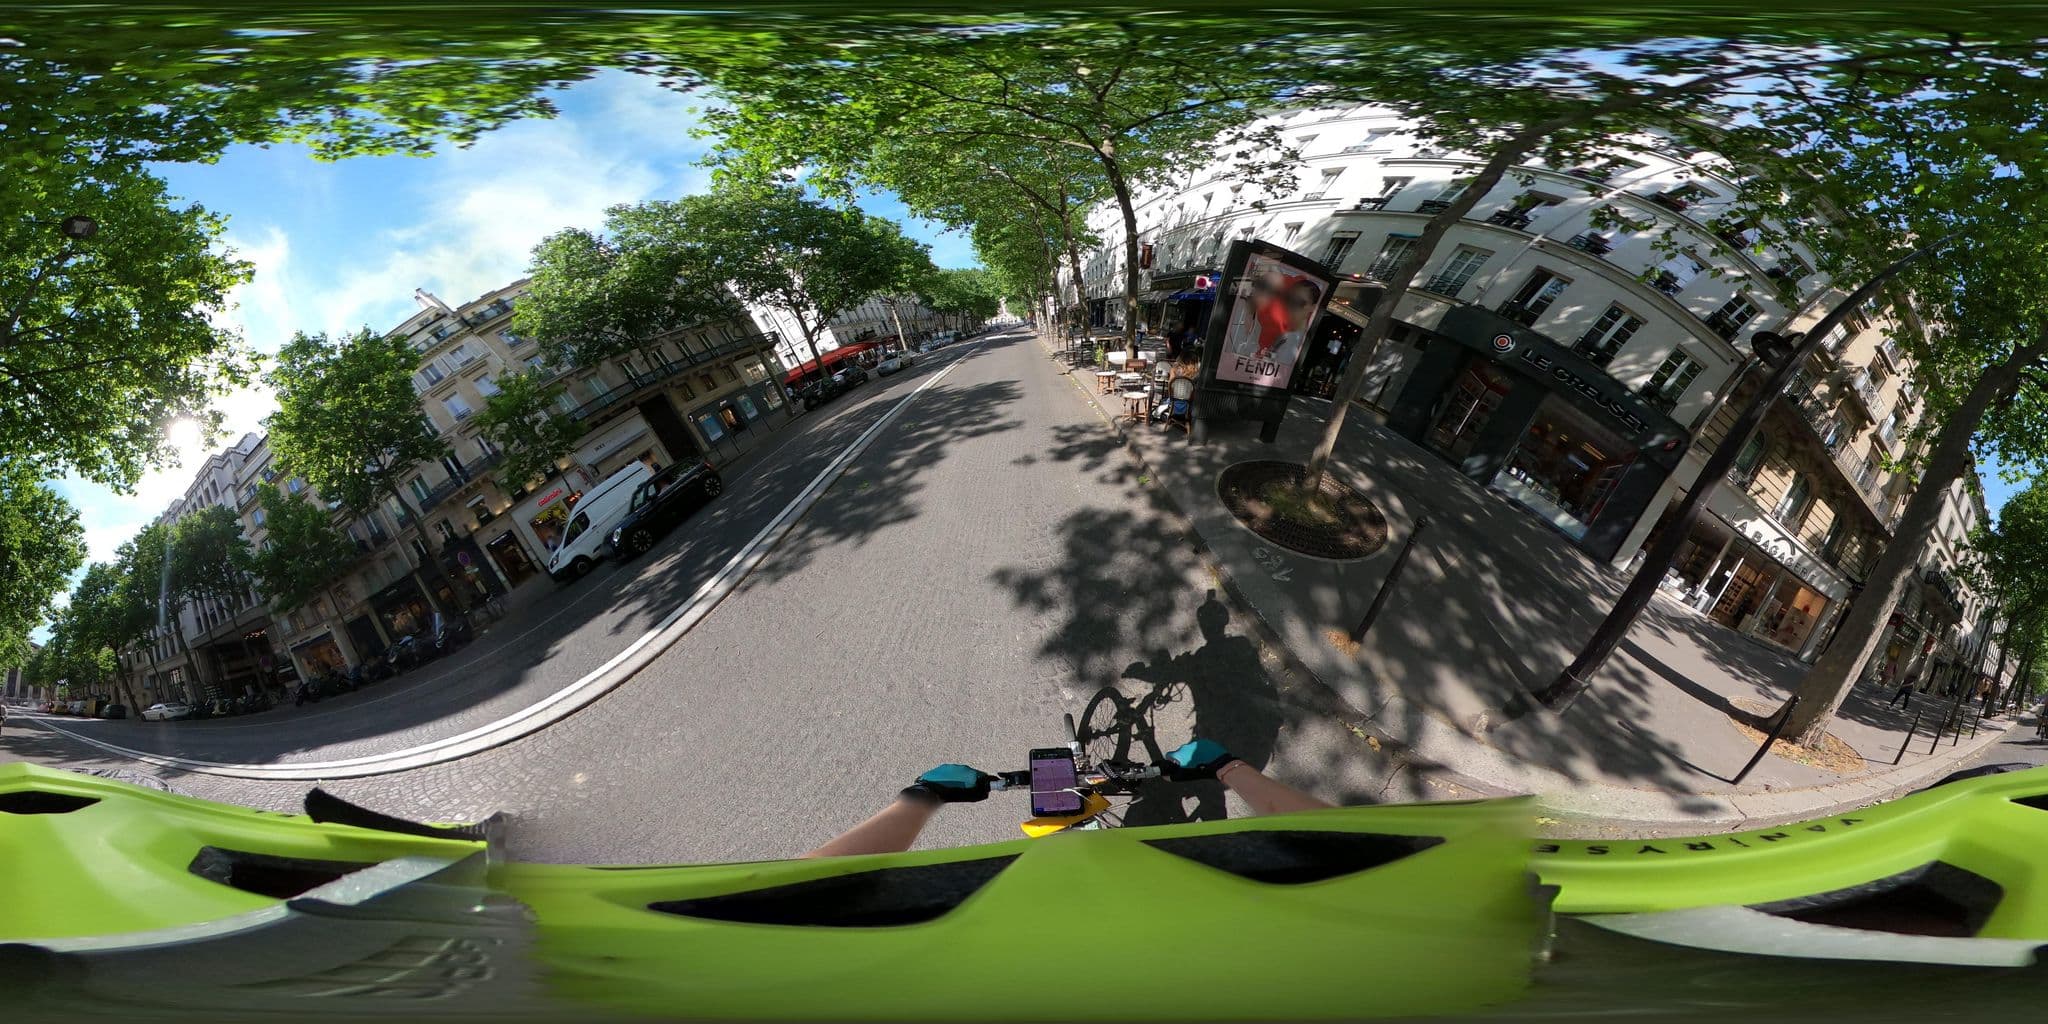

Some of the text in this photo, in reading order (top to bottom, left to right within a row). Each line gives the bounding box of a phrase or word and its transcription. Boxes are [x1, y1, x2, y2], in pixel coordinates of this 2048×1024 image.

[1235, 356, 1280, 378] FENDI
[1520, 348, 1649, 434] LE CREUSET
[1729, 512, 1748, 533] LA
